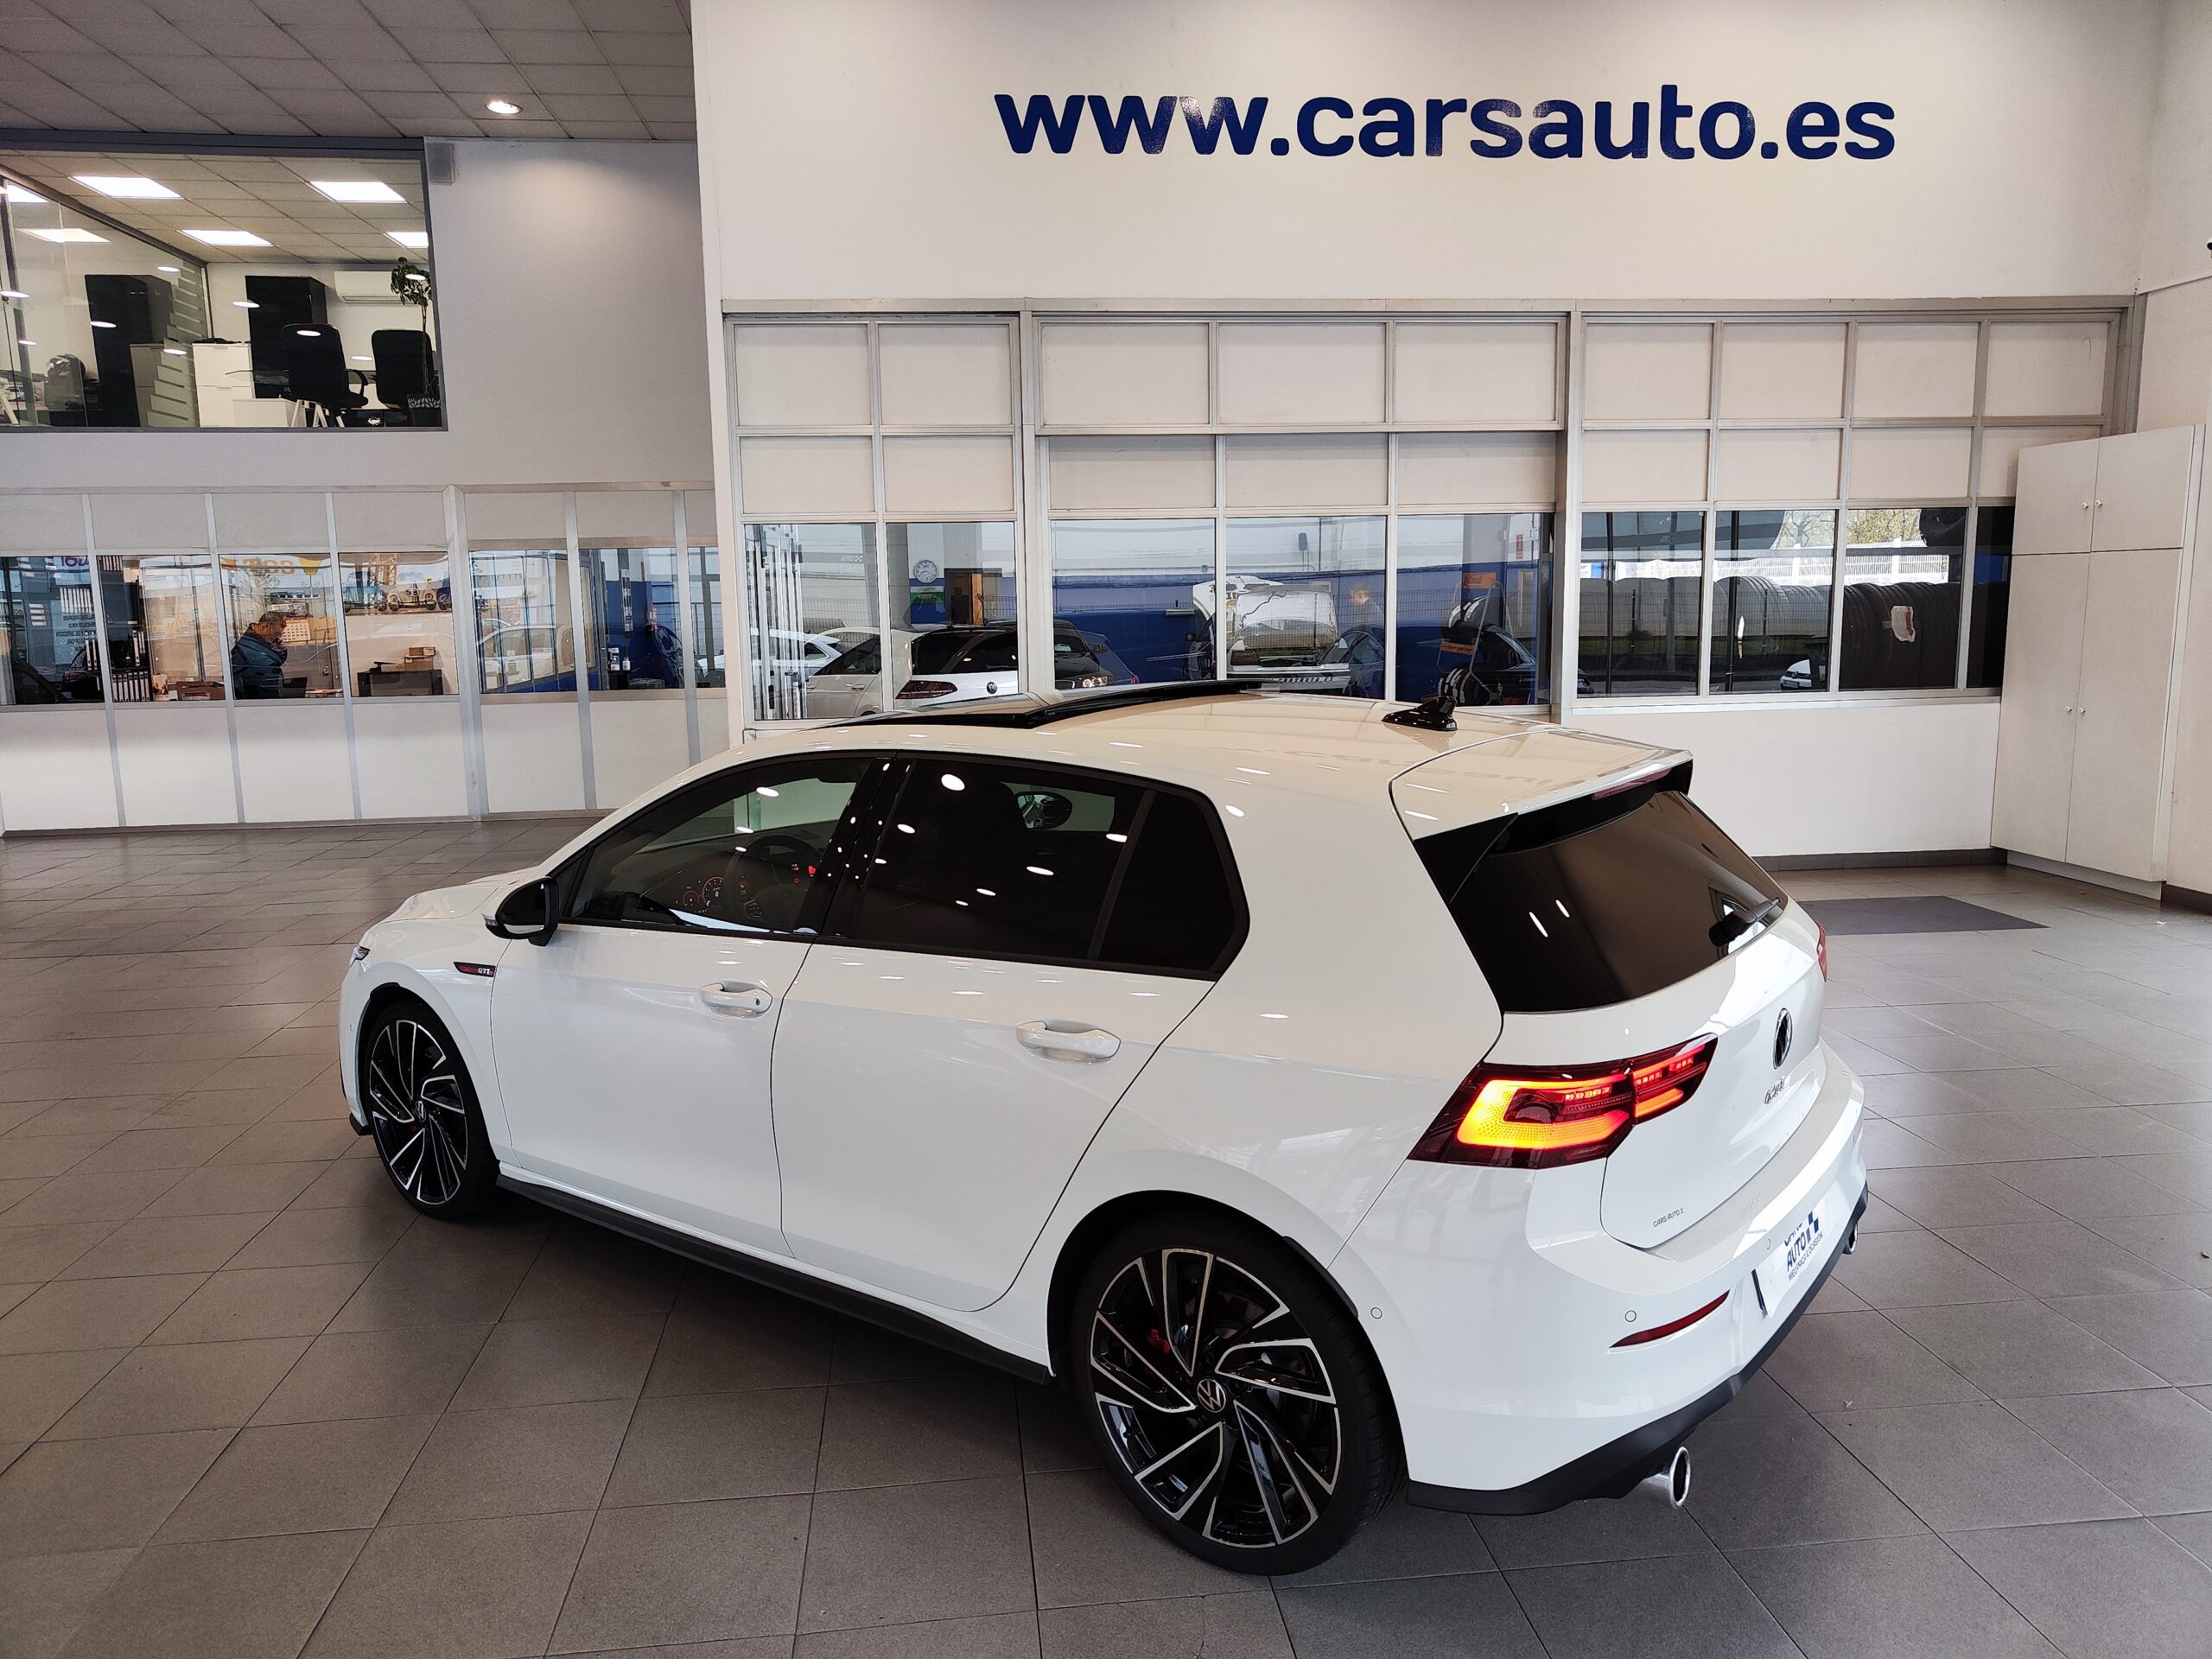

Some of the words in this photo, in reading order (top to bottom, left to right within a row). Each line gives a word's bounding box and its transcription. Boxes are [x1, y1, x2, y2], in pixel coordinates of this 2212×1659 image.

[994, 84, 1896, 160] www.carsauto.es
[1653, 1216, 1668, 1228] CARS
[1668, 1210, 1681, 1220] AUTO
[1787, 1232, 1806, 1272] AUTO
